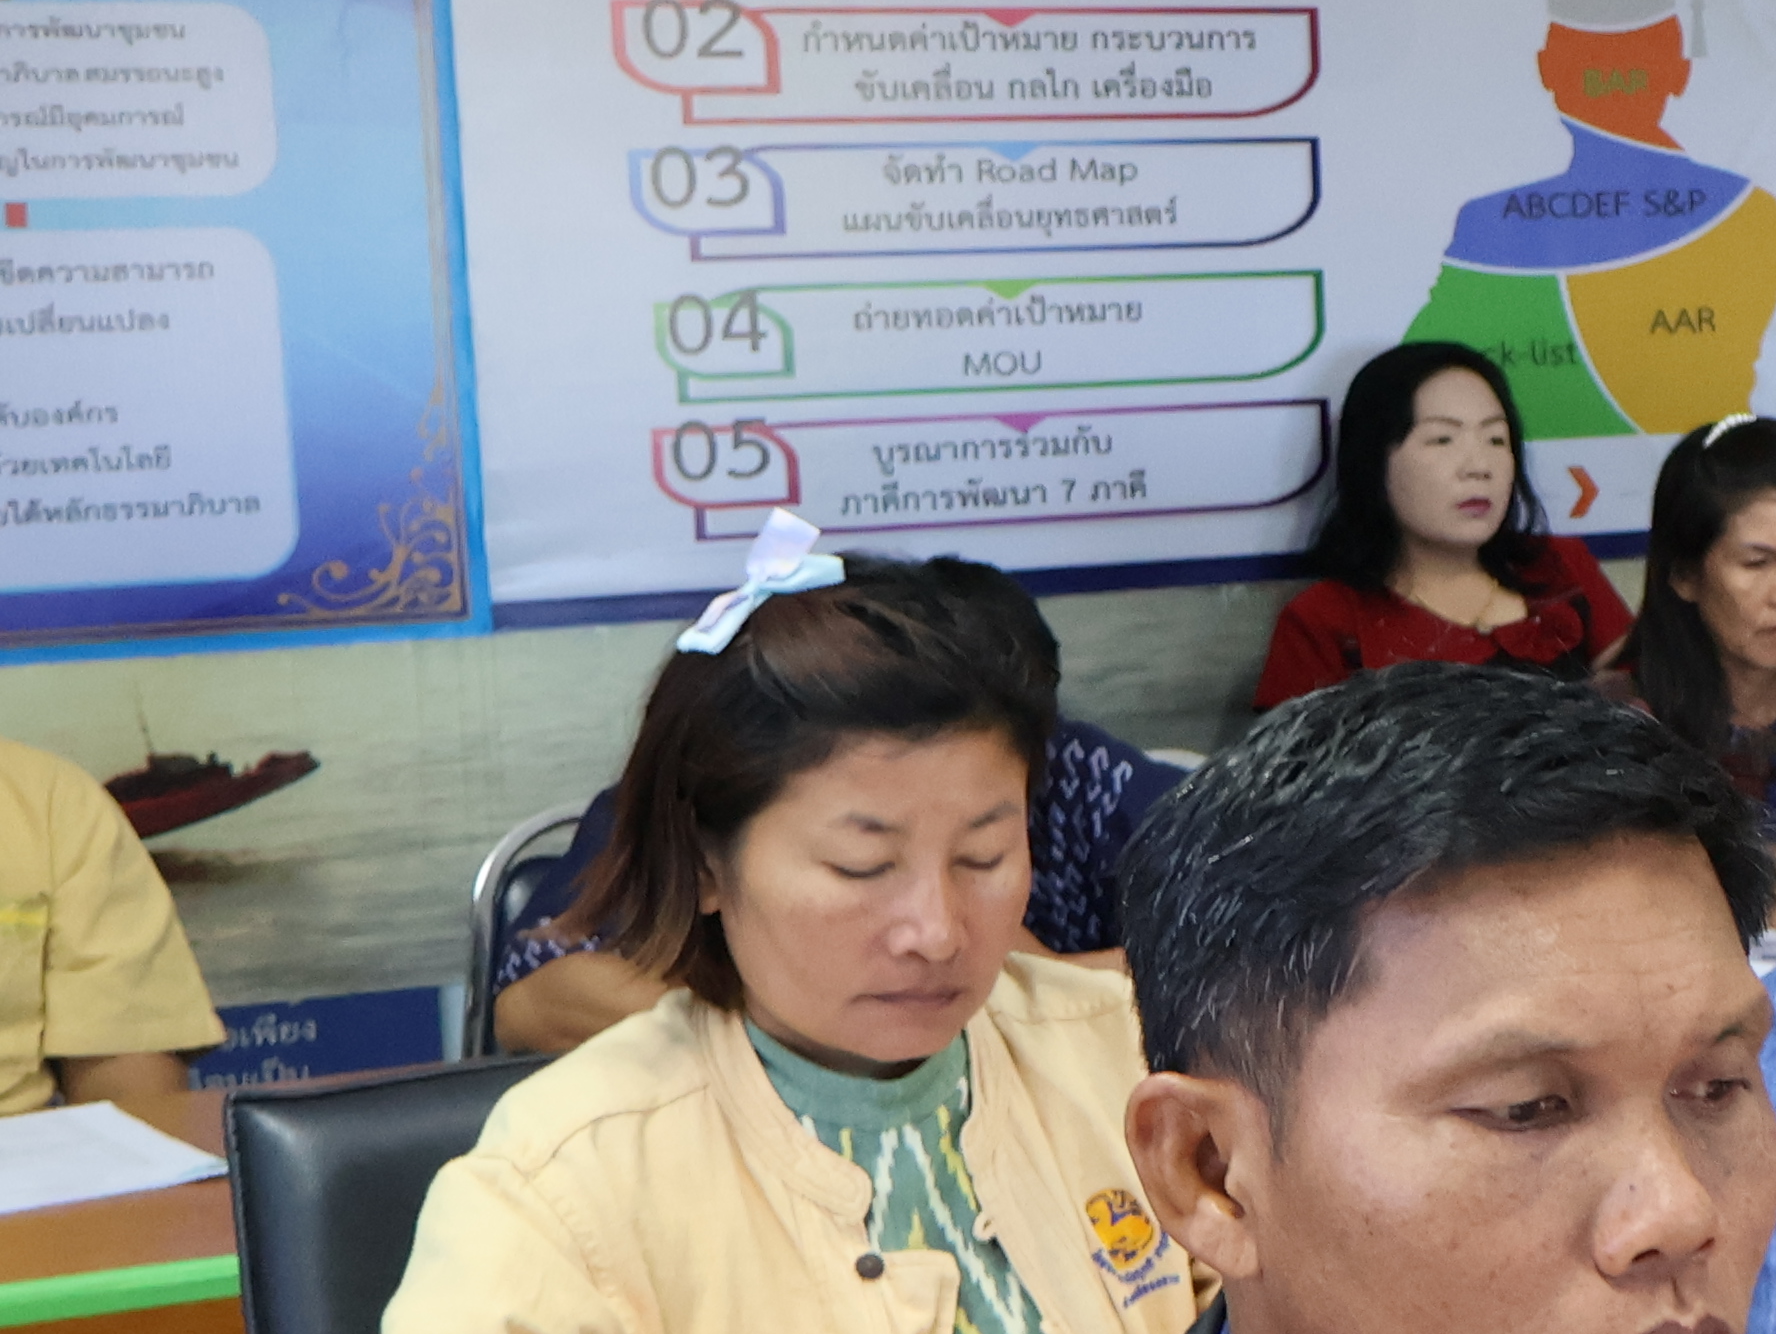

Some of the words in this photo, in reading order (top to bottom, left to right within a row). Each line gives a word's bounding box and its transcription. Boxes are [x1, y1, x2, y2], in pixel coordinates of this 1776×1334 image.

[1091, 23, 1258, 54] กระบวนการ
[649, 145, 752, 210] 03
[976, 156, 1057, 188] Road
[1069, 156, 1140, 191] Map
[1503, 192, 1631, 220] ABCDEF
[1644, 189, 1707, 218] S&P
[668, 291, 768, 356] 04
[1650, 307, 1717, 334] AAR
[963, 349, 1043, 378] MOU
[671, 420, 772, 482] 05
[1061, 479, 1078, 506] 7
